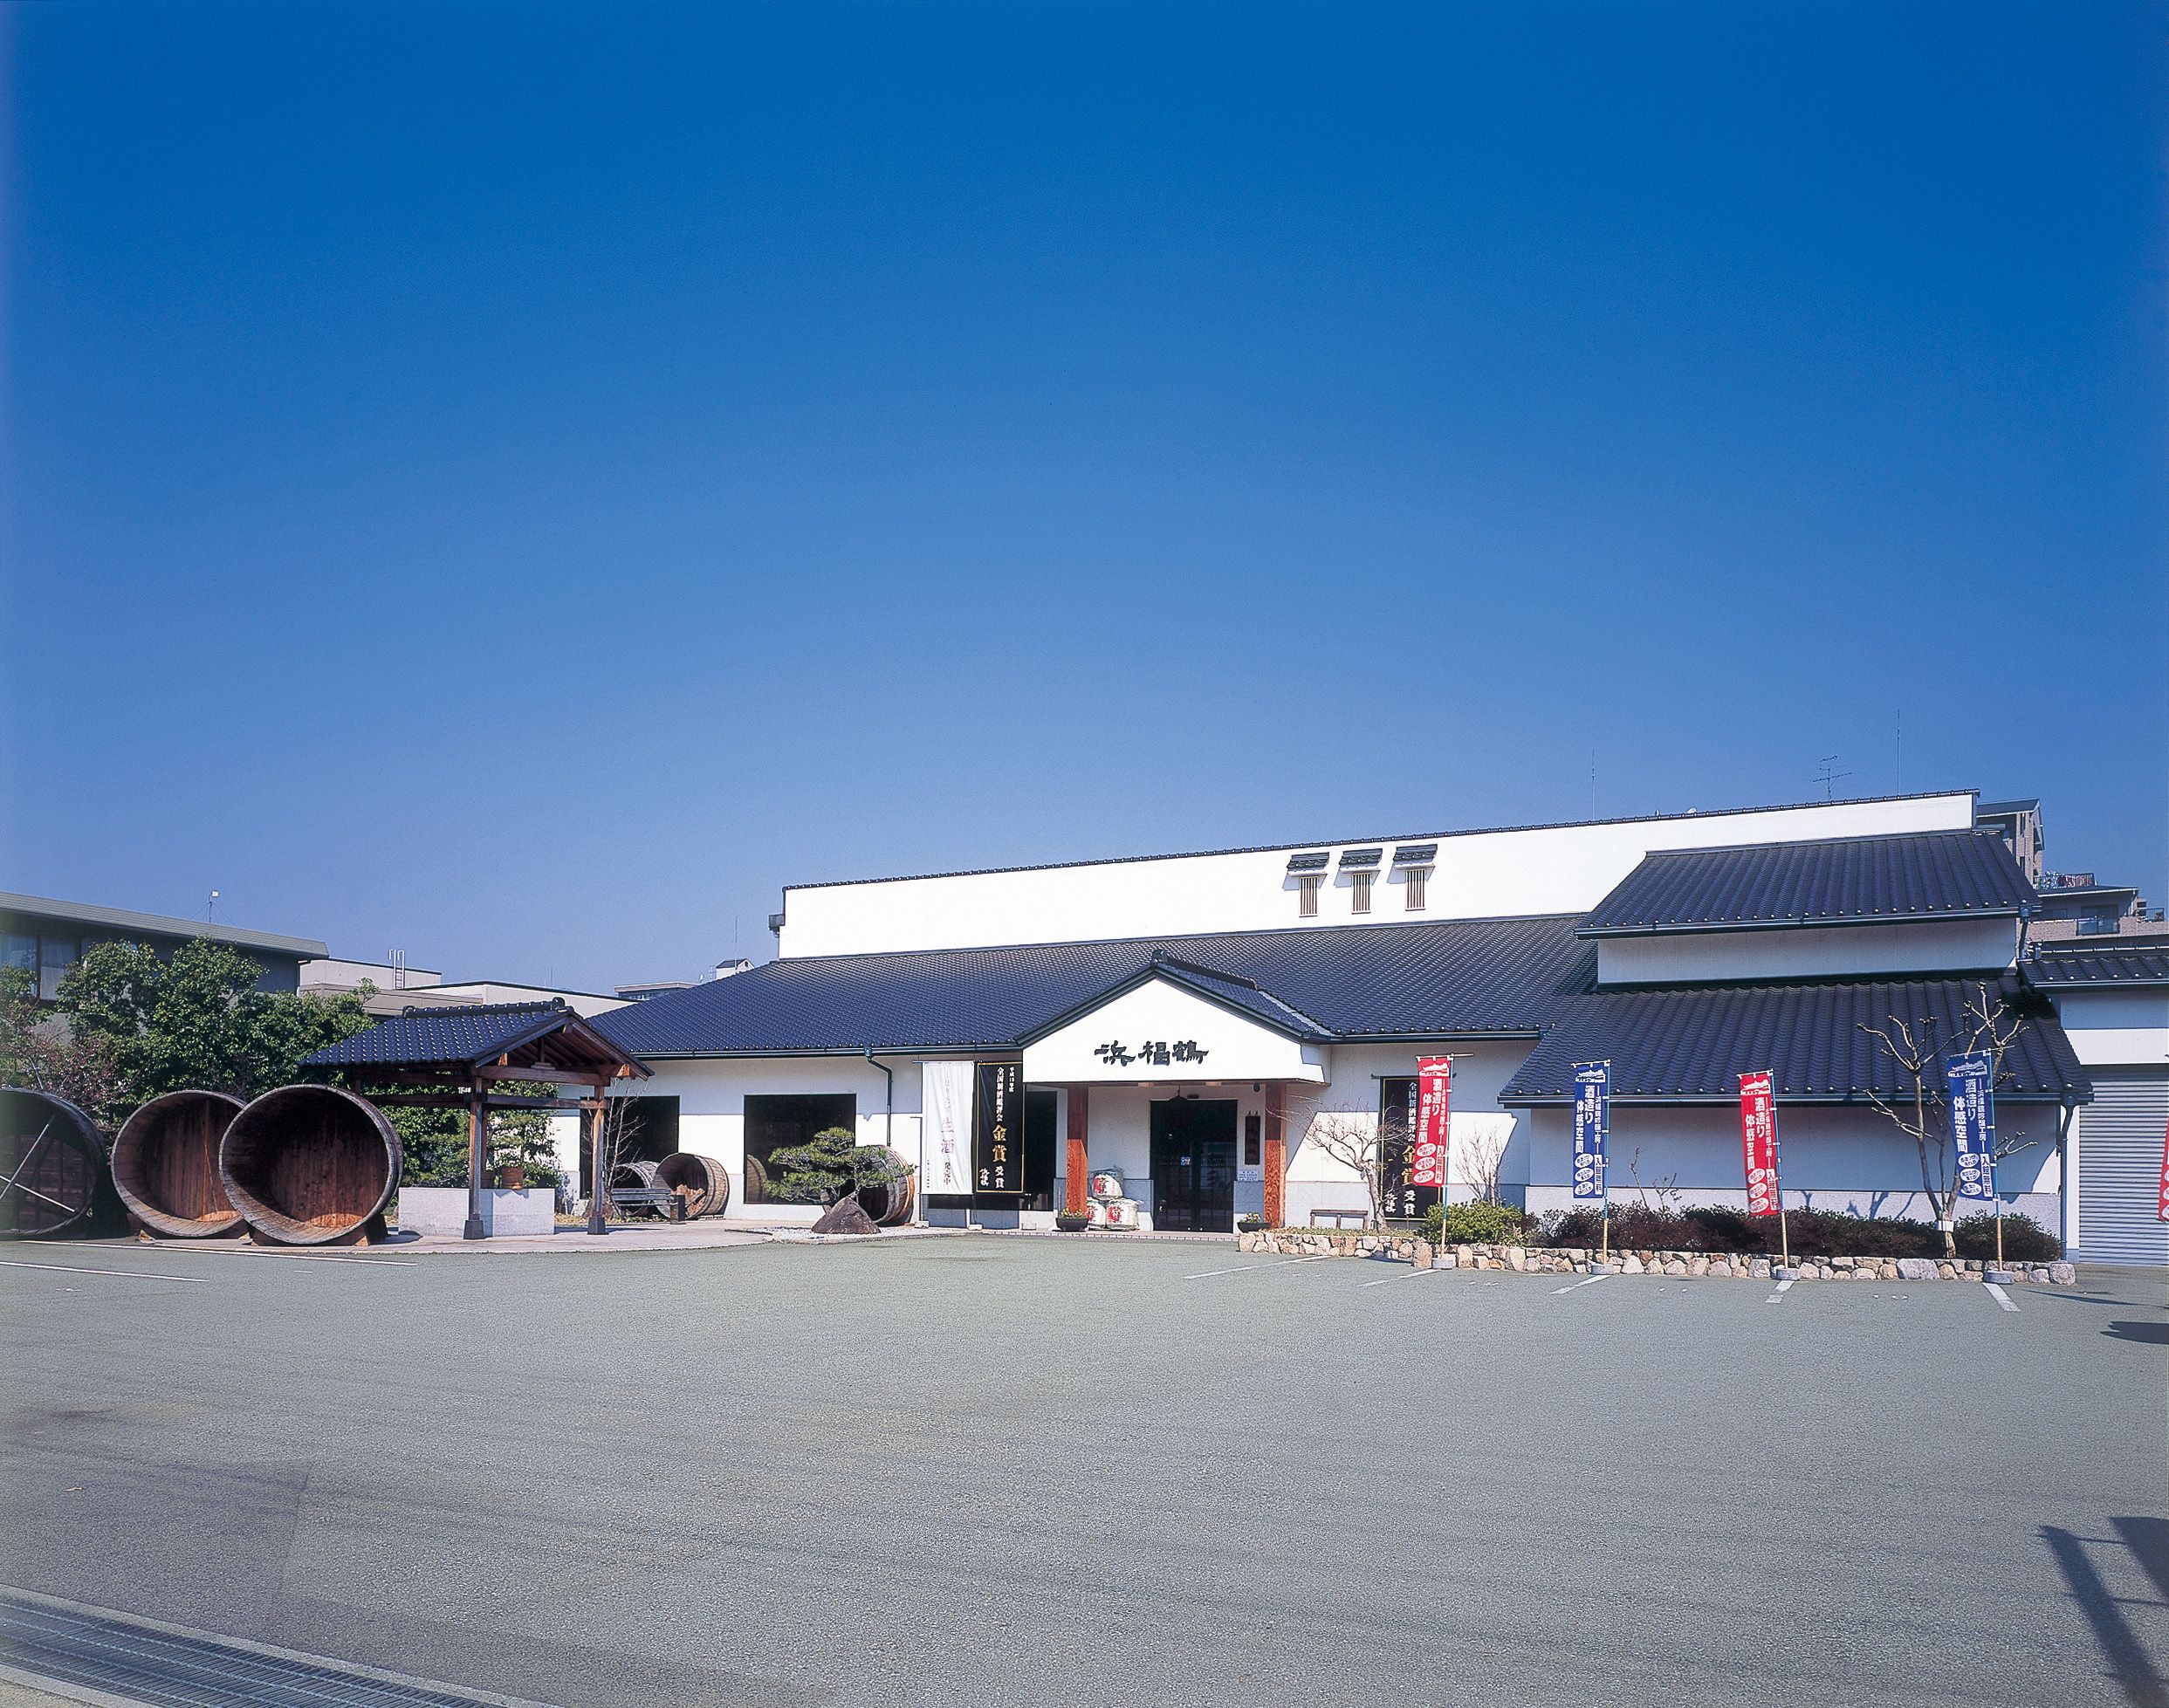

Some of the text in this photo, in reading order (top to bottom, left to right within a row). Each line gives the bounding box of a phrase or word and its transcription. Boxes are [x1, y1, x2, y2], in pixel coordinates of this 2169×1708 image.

[1094, 1039, 1210, 1067] 浜福鶴
[1431, 1079, 1443, 1116] 酒造り
[1584, 1085, 1596, 1124] 酒造り
[1754, 1097, 1766, 1138] 酒造り
[1965, 1079, 1977, 1122] 酒造り
[1417, 1093, 1432, 1144] 体感空間
[1575, 1100, 1585, 1154] 体感空間
[1953, 1096, 1968, 1154] 体感空間
[992, 1124, 1007, 1163] 金賞
[1745, 1114, 1755, 1170] 体感空間
[994, 1165, 1005, 1189] 受賞
[1404, 1190, 1416, 1216] 受賞
